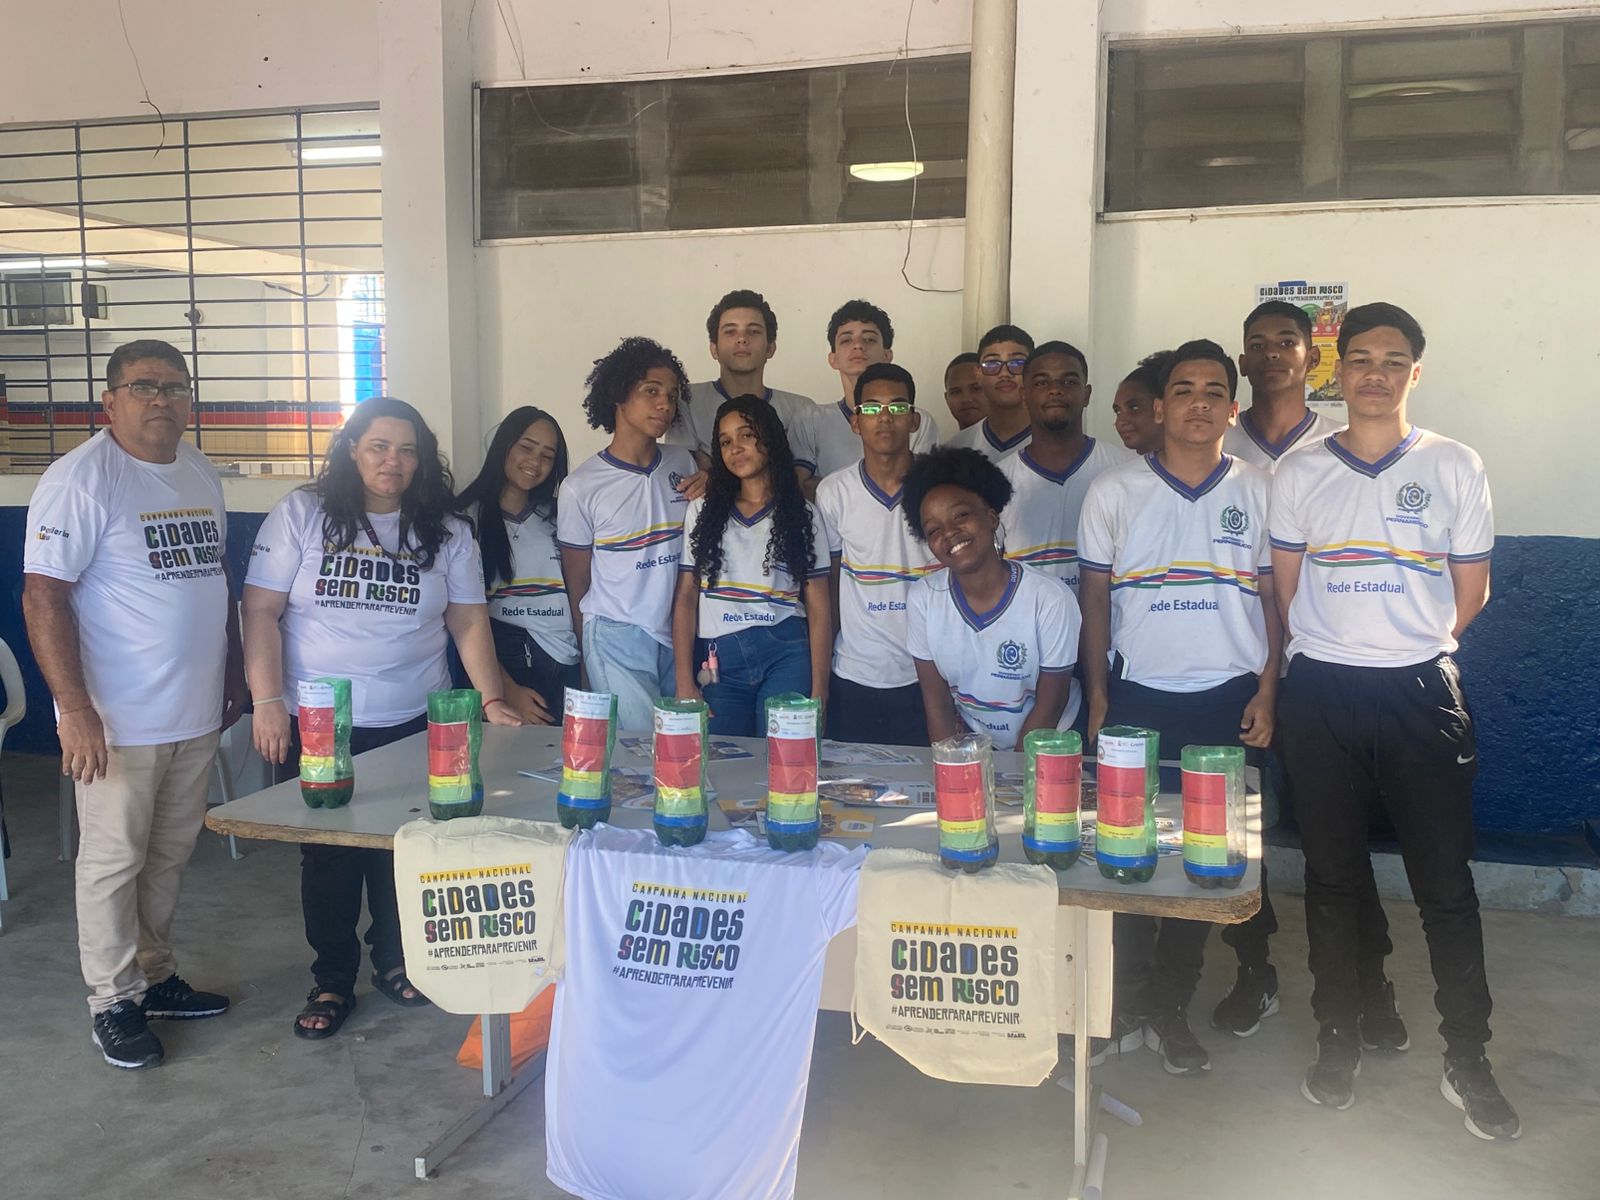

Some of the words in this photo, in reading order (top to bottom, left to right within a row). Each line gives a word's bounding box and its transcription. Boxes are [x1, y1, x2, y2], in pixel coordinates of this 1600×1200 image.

[636, 558, 657, 570] Rede
[1327, 582, 1351, 593] Rede
[1354, 581, 1405, 594] Estadual
[502, 607, 525, 617] Rede
[527, 607, 564, 617] Estadual
[868, 601, 887, 611] Rede
[888, 601, 906, 611] Esta
[1148, 600, 1171, 612] ede
[1174, 599, 1219, 611] Estadua
[722, 612, 743, 622] Rede
[744, 612, 775, 622] Estadu
[420, 872, 472, 884] CAMPANHA
[479, 864, 532, 878] NACIONAL
[632, 883, 687, 900] CAMPANHA
[693, 891, 747, 904] NACIONAL
[891, 923, 950, 937] CAMPANHA
[957, 927, 1017, 939] NACIONAL
[428, 940, 538, 959] #APRENDERPARAPREVENIR
[613, 965, 734, 990] #APRENDERPARAPREVENIR
[891, 1005, 1020, 1025] #APRENDERPARAPREVENIR
